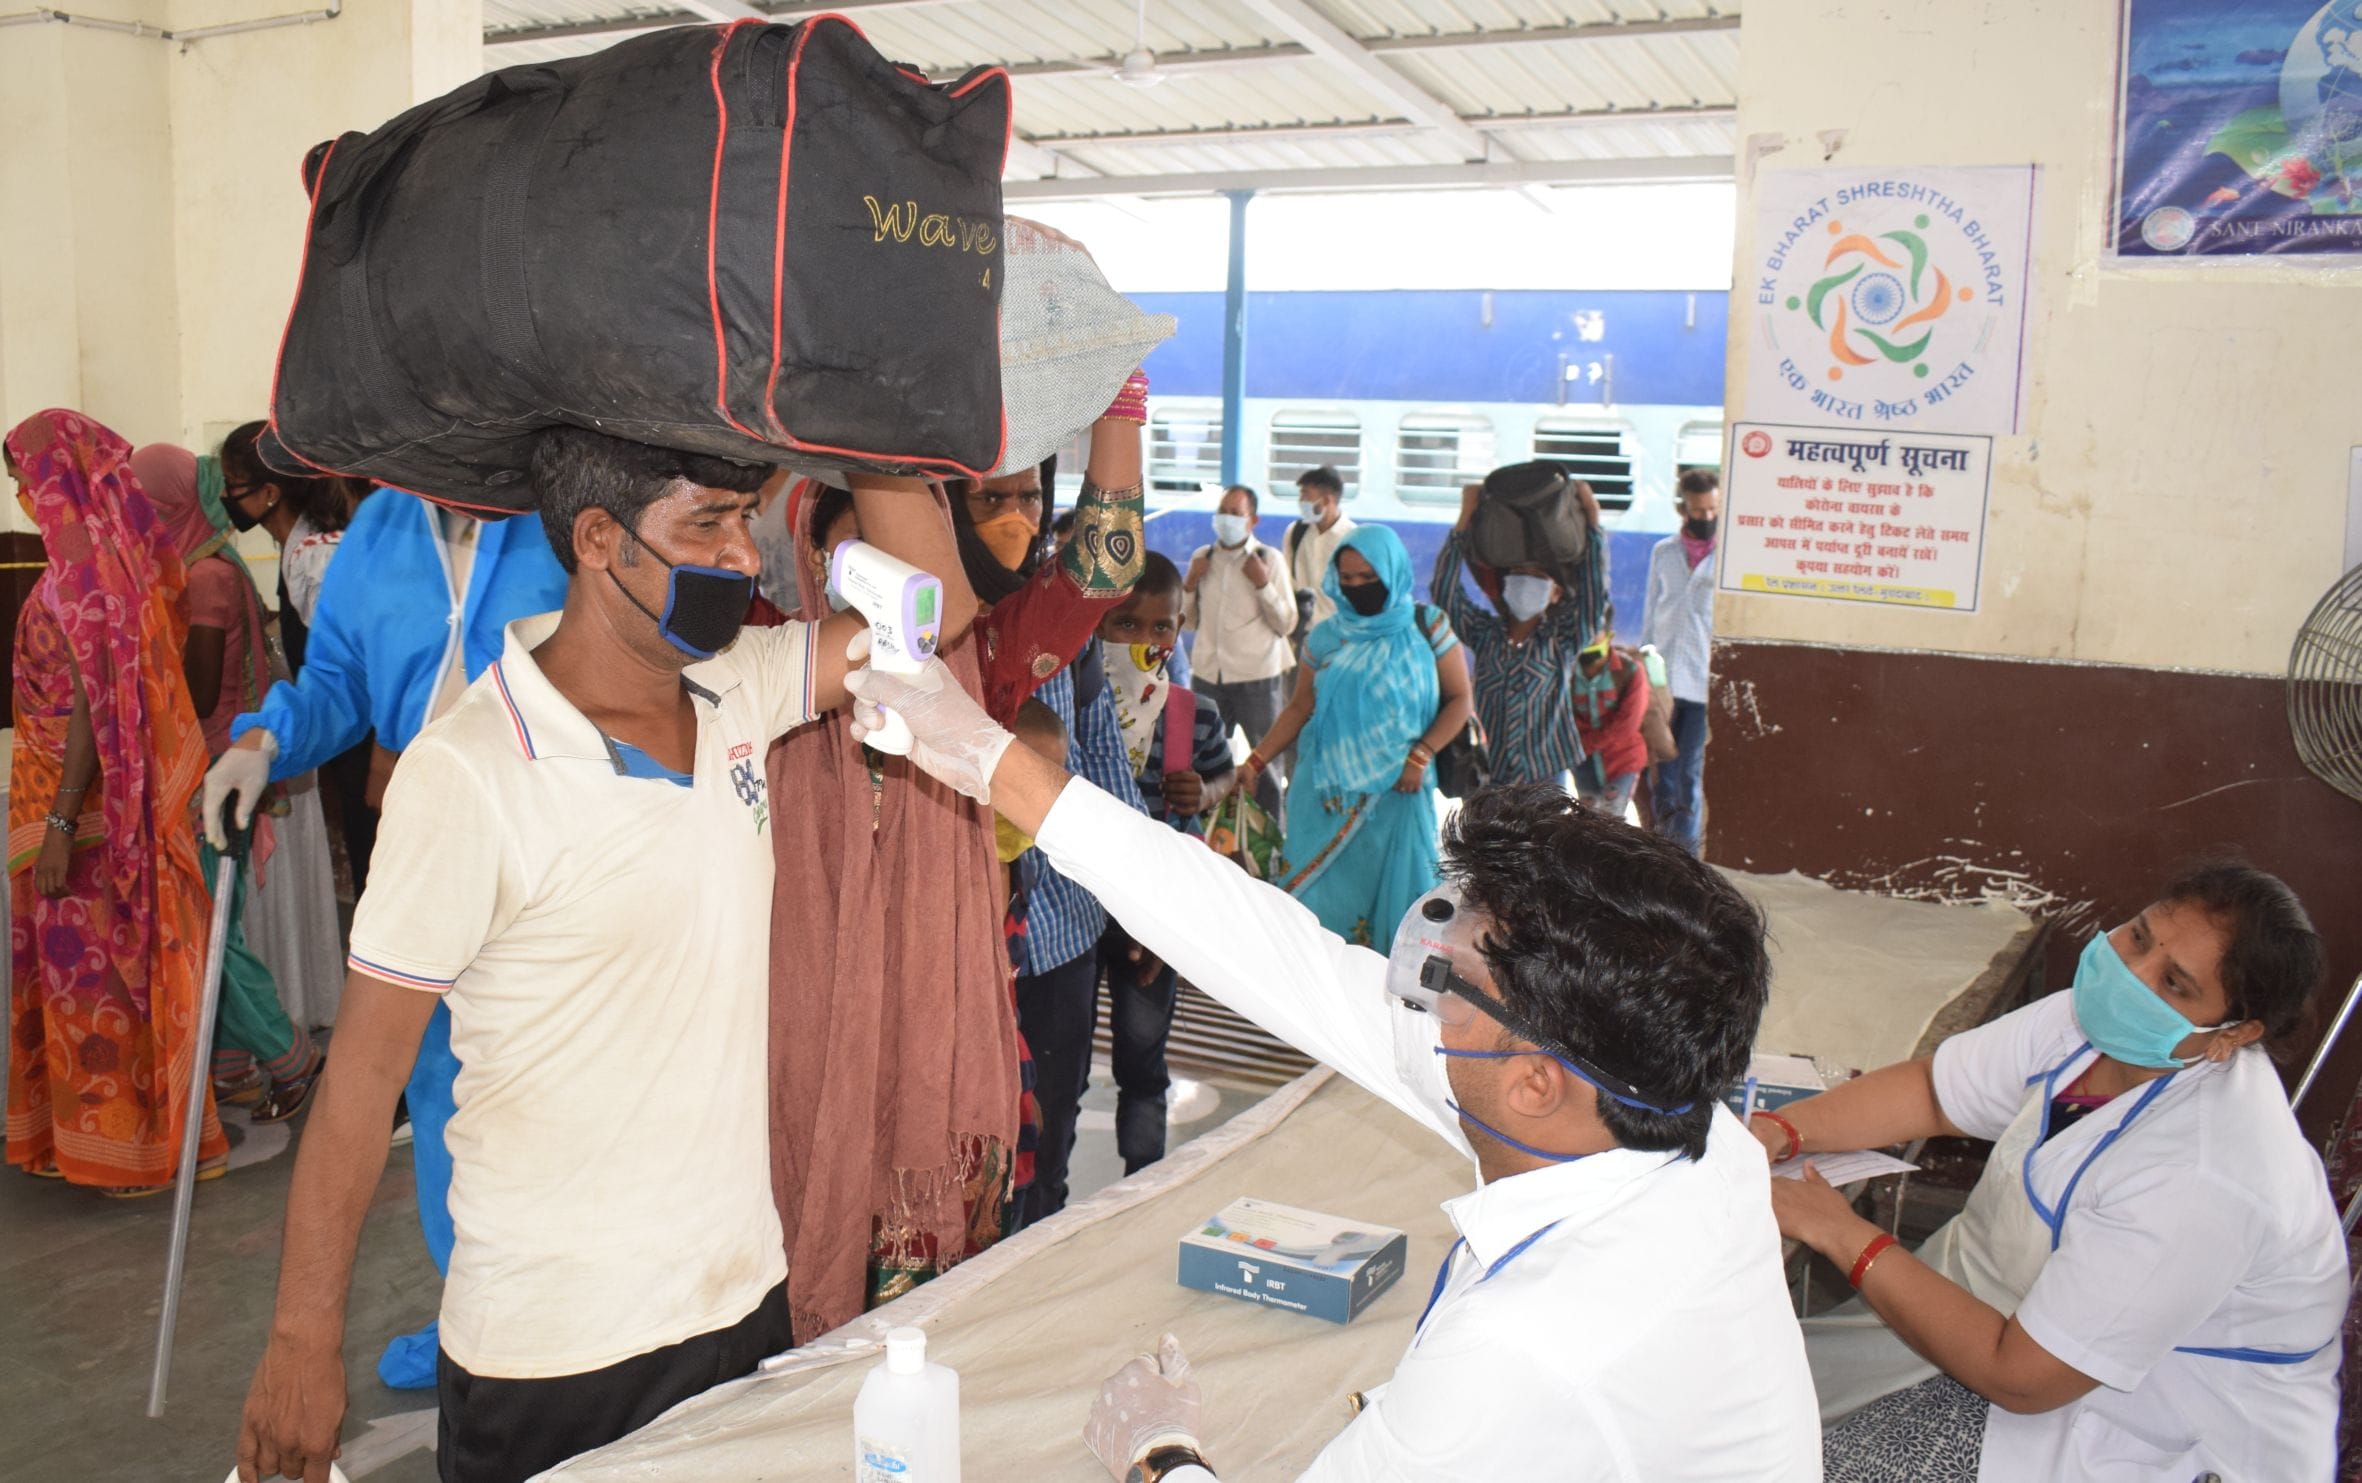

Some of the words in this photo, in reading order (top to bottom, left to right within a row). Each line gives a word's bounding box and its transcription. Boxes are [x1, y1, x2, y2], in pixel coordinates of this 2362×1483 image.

[1836, 181, 1966, 224] SHRESHTHA
[863, 195, 997, 255] Wave
[1767, 197, 1831, 271] BHARAT
[1963, 220, 2004, 307] BHARAT
[1759, 277, 1777, 305] EK
[1779, 358, 1806, 392] एक
[1810, 389, 1864, 420] भारत
[1873, 399, 1918, 421] श्रेष्ठ
[1924, 361, 1975, 405] भारत
[1786, 438, 1890, 473] महत्वपूर्ण
[1900, 446, 1970, 477] सूचना
[1823, 477, 1833, 491] के
[1838, 477, 1861, 492] लिए
[1906, 482, 1913, 496] है
[1918, 482, 1934, 498] कि
[1805, 497, 1844, 512] कोरोना
[1848, 502, 1884, 515] वायरस
[1890, 502, 1901, 516] के
[1769, 514, 1784, 528] को
[1880, 522, 1910, 538] टिकट
[1940, 529, 1969, 542] समय
[1764, 537, 1796, 550] आपस
[1796, 559, 1828, 575] कृपया
[1834, 561, 1872, 577] सहयोग
[1215, 1282, 1242, 1295] Infrared
[1243, 1288, 1261, 1301] Body
[1262, 1293, 1308, 1311] Thermometer
[1266, 1279, 1286, 1291] IRBT
